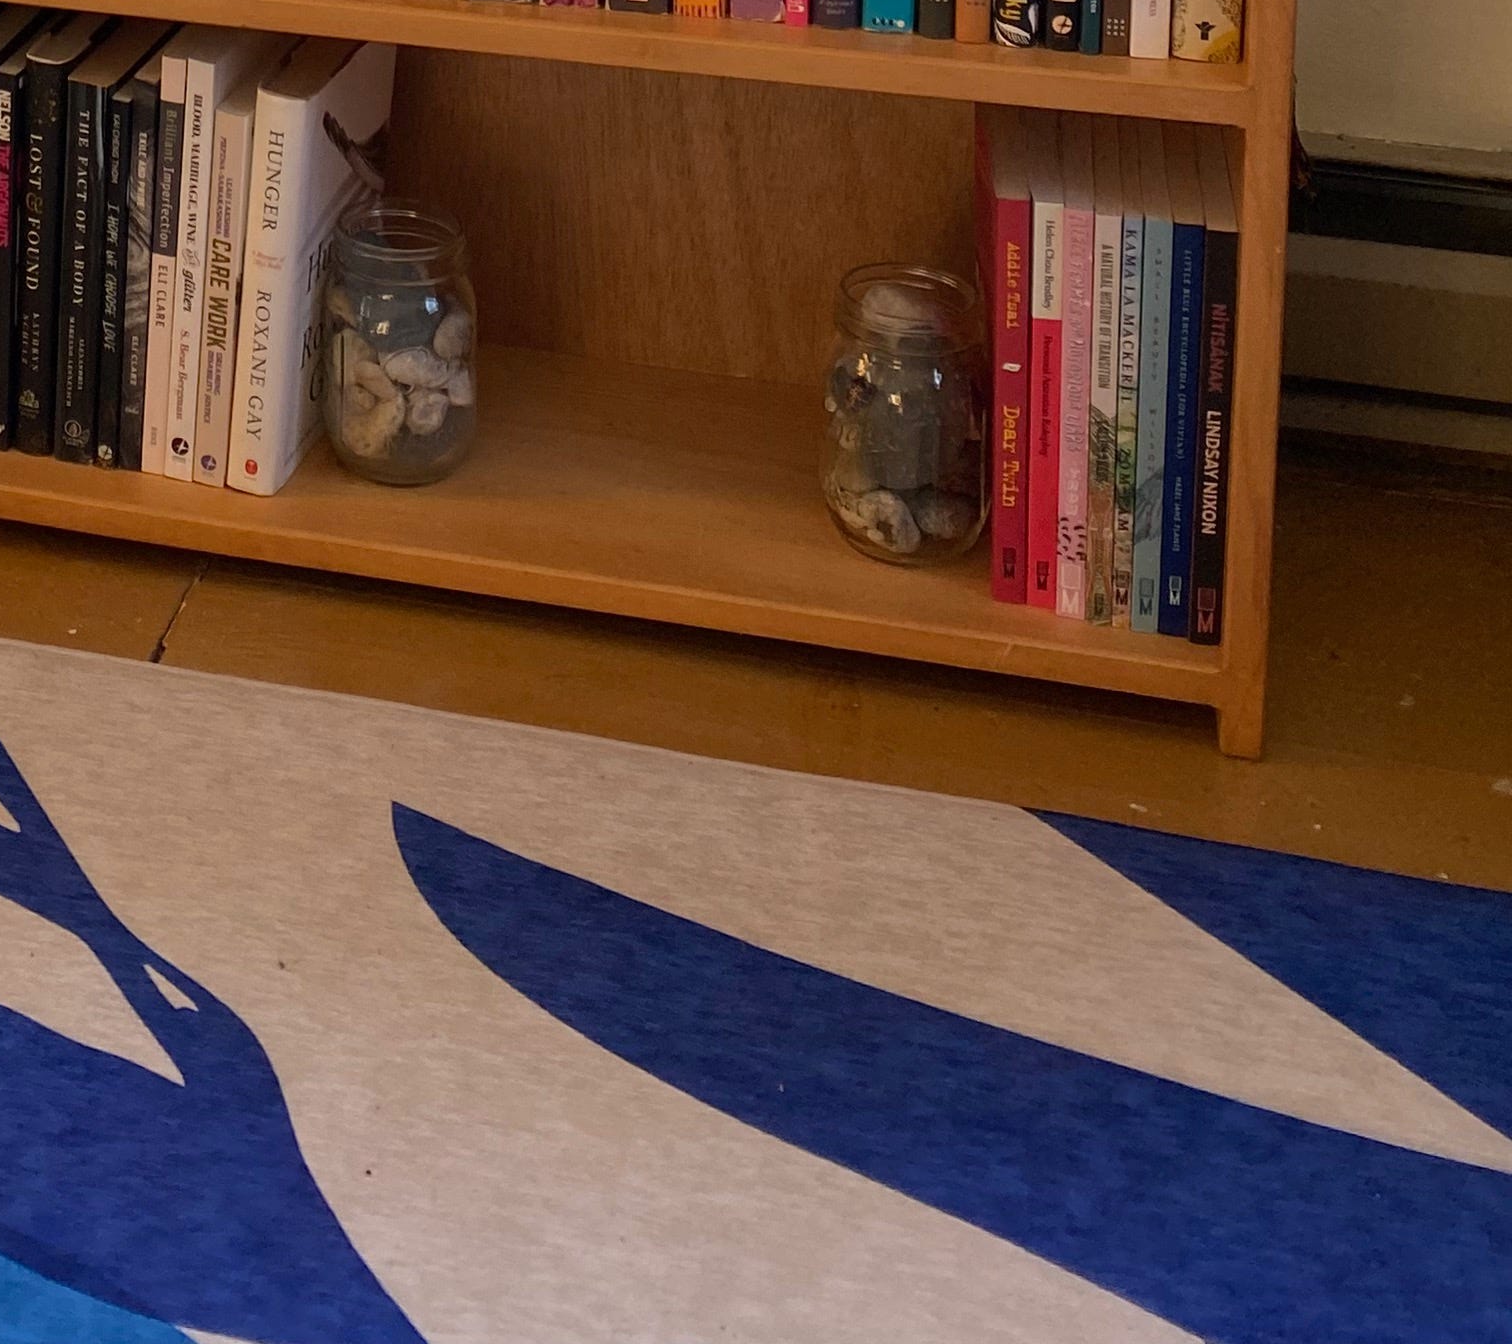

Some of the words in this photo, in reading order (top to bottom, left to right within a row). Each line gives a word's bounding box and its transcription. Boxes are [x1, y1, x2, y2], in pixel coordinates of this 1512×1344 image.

[78, 109, 90, 149] THE
[163, 108, 178, 165] Brilliant
[28, 133, 43, 191] LOST
[76, 155, 88, 203] FACT
[262, 129, 285, 231] HUNGER
[25, 192, 42, 214] &
[75, 209, 86, 234] OF
[159, 166, 175, 249] Imperfection
[25, 216, 41, 291] FOUND
[73, 240, 85, 251] A
[209, 237, 232, 292] CARE
[1006, 241, 1021, 289] Addie
[1124, 229, 1137, 279] KAMA
[1182, 248, 1193, 285] LITTLE
[71, 258, 85, 309] BODY
[156, 265, 169, 286] ELI
[1123, 285, 1136, 308] LA
[1182, 287, 1192, 314] BLUE
[155, 288, 168, 328] CLARE
[206, 295, 229, 352] WORK
[1006, 291, 1021, 329] Tsai
[249, 289, 273, 389] ROXANE
[1120, 314, 1136, 405] MACKEREL
[1177, 315, 1190, 391] ENCYCLOPEDIA
[246, 395, 265, 441] GAY
[1002, 405, 1021, 455] Dear
[1202, 410, 1222, 481] LINDSAY
[1001, 460, 1020, 508] Twin
[1201, 482, 1219, 535] NIXON
